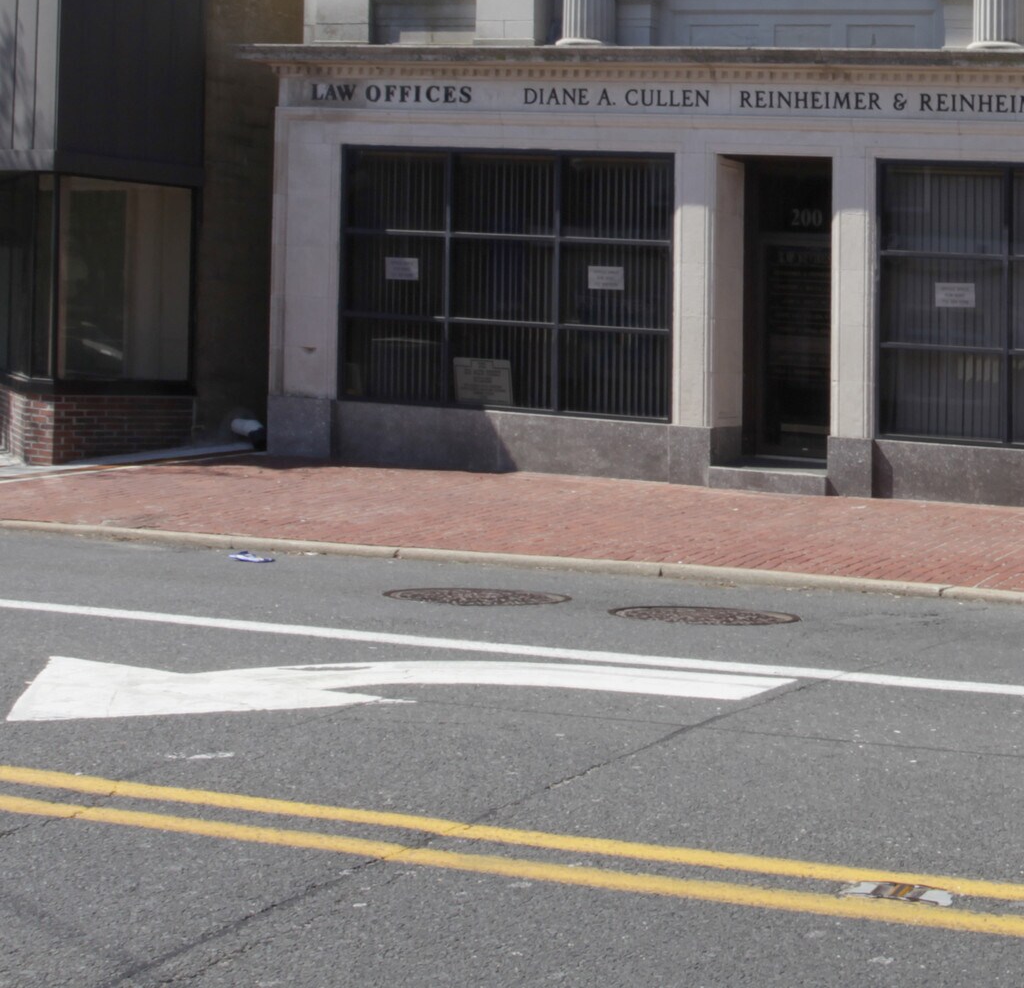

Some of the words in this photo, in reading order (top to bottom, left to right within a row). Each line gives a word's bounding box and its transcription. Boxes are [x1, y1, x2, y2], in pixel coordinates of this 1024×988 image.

[310, 84, 357, 103] LAW
[366, 85, 471, 103] OFFICES
[524, 88, 589, 105] DIANE
[597, 88, 616, 106] A.
[625, 89, 709, 107] CULLEN
[740, 91, 881, 110] REINHEIMER
[893, 93, 907, 111] &
[791, 208, 823, 227] 200
